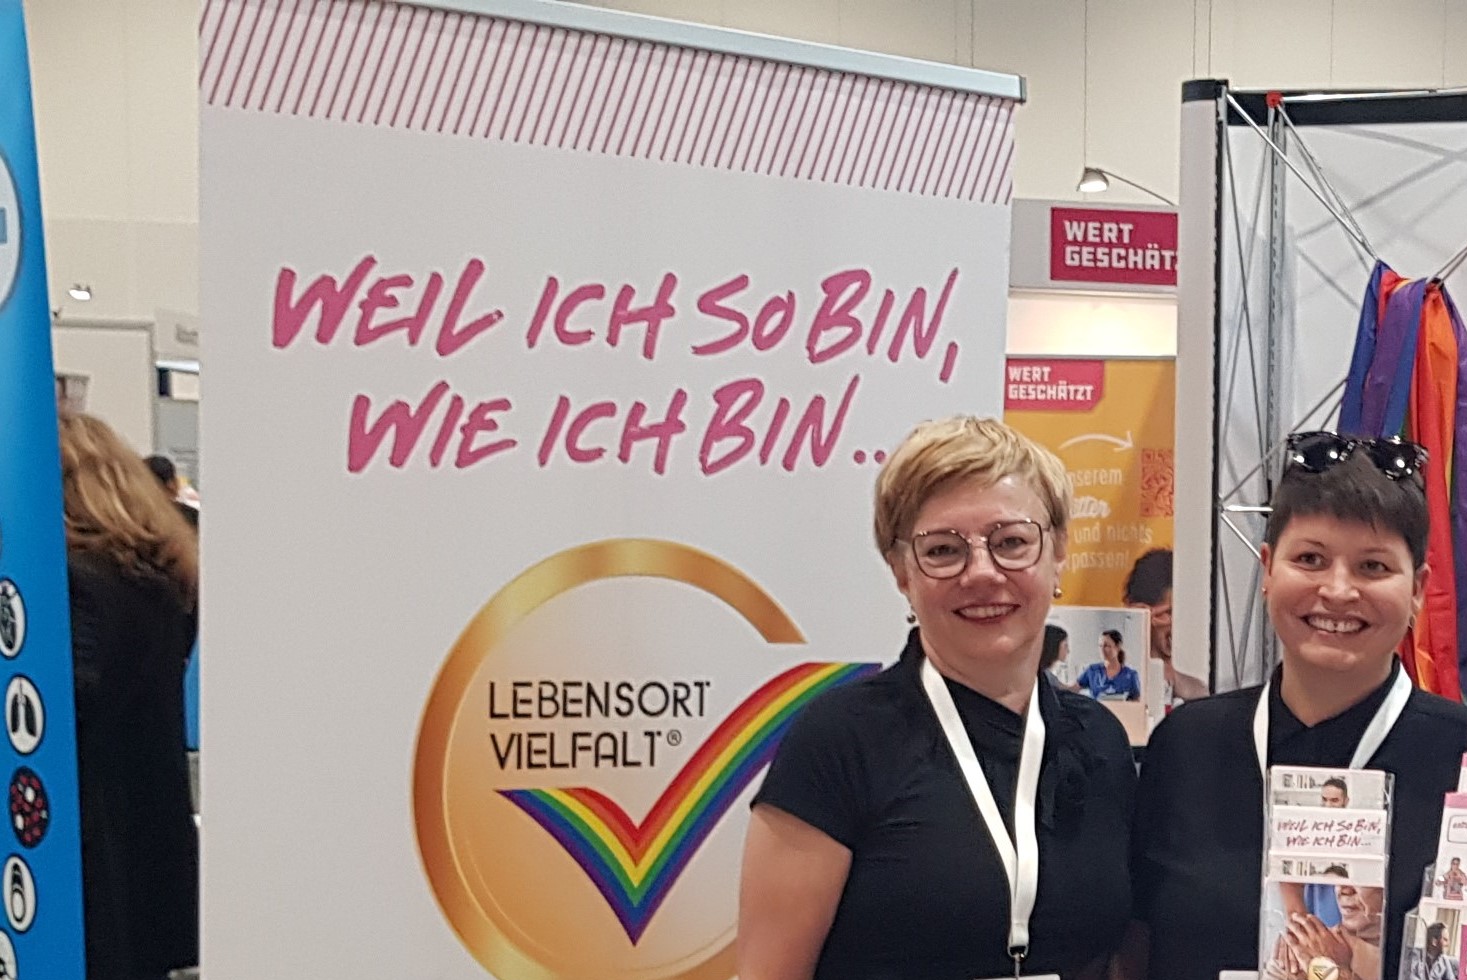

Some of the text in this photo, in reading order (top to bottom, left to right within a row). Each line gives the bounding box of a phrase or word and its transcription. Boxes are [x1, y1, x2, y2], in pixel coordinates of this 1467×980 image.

[1063, 220, 1134, 244] WERT
[273, 256, 959, 382] WEIL ICH SO BIN,
[1008, 366, 1051, 382] WERT
[1008, 380, 1093, 400] GESCHÄTZT
[347, 381, 517, 473] WIE
[538, 389, 687, 474] ICH
[1074, 522, 1153, 545] und nichts
[489, 681, 711, 718] LEBENSORT
